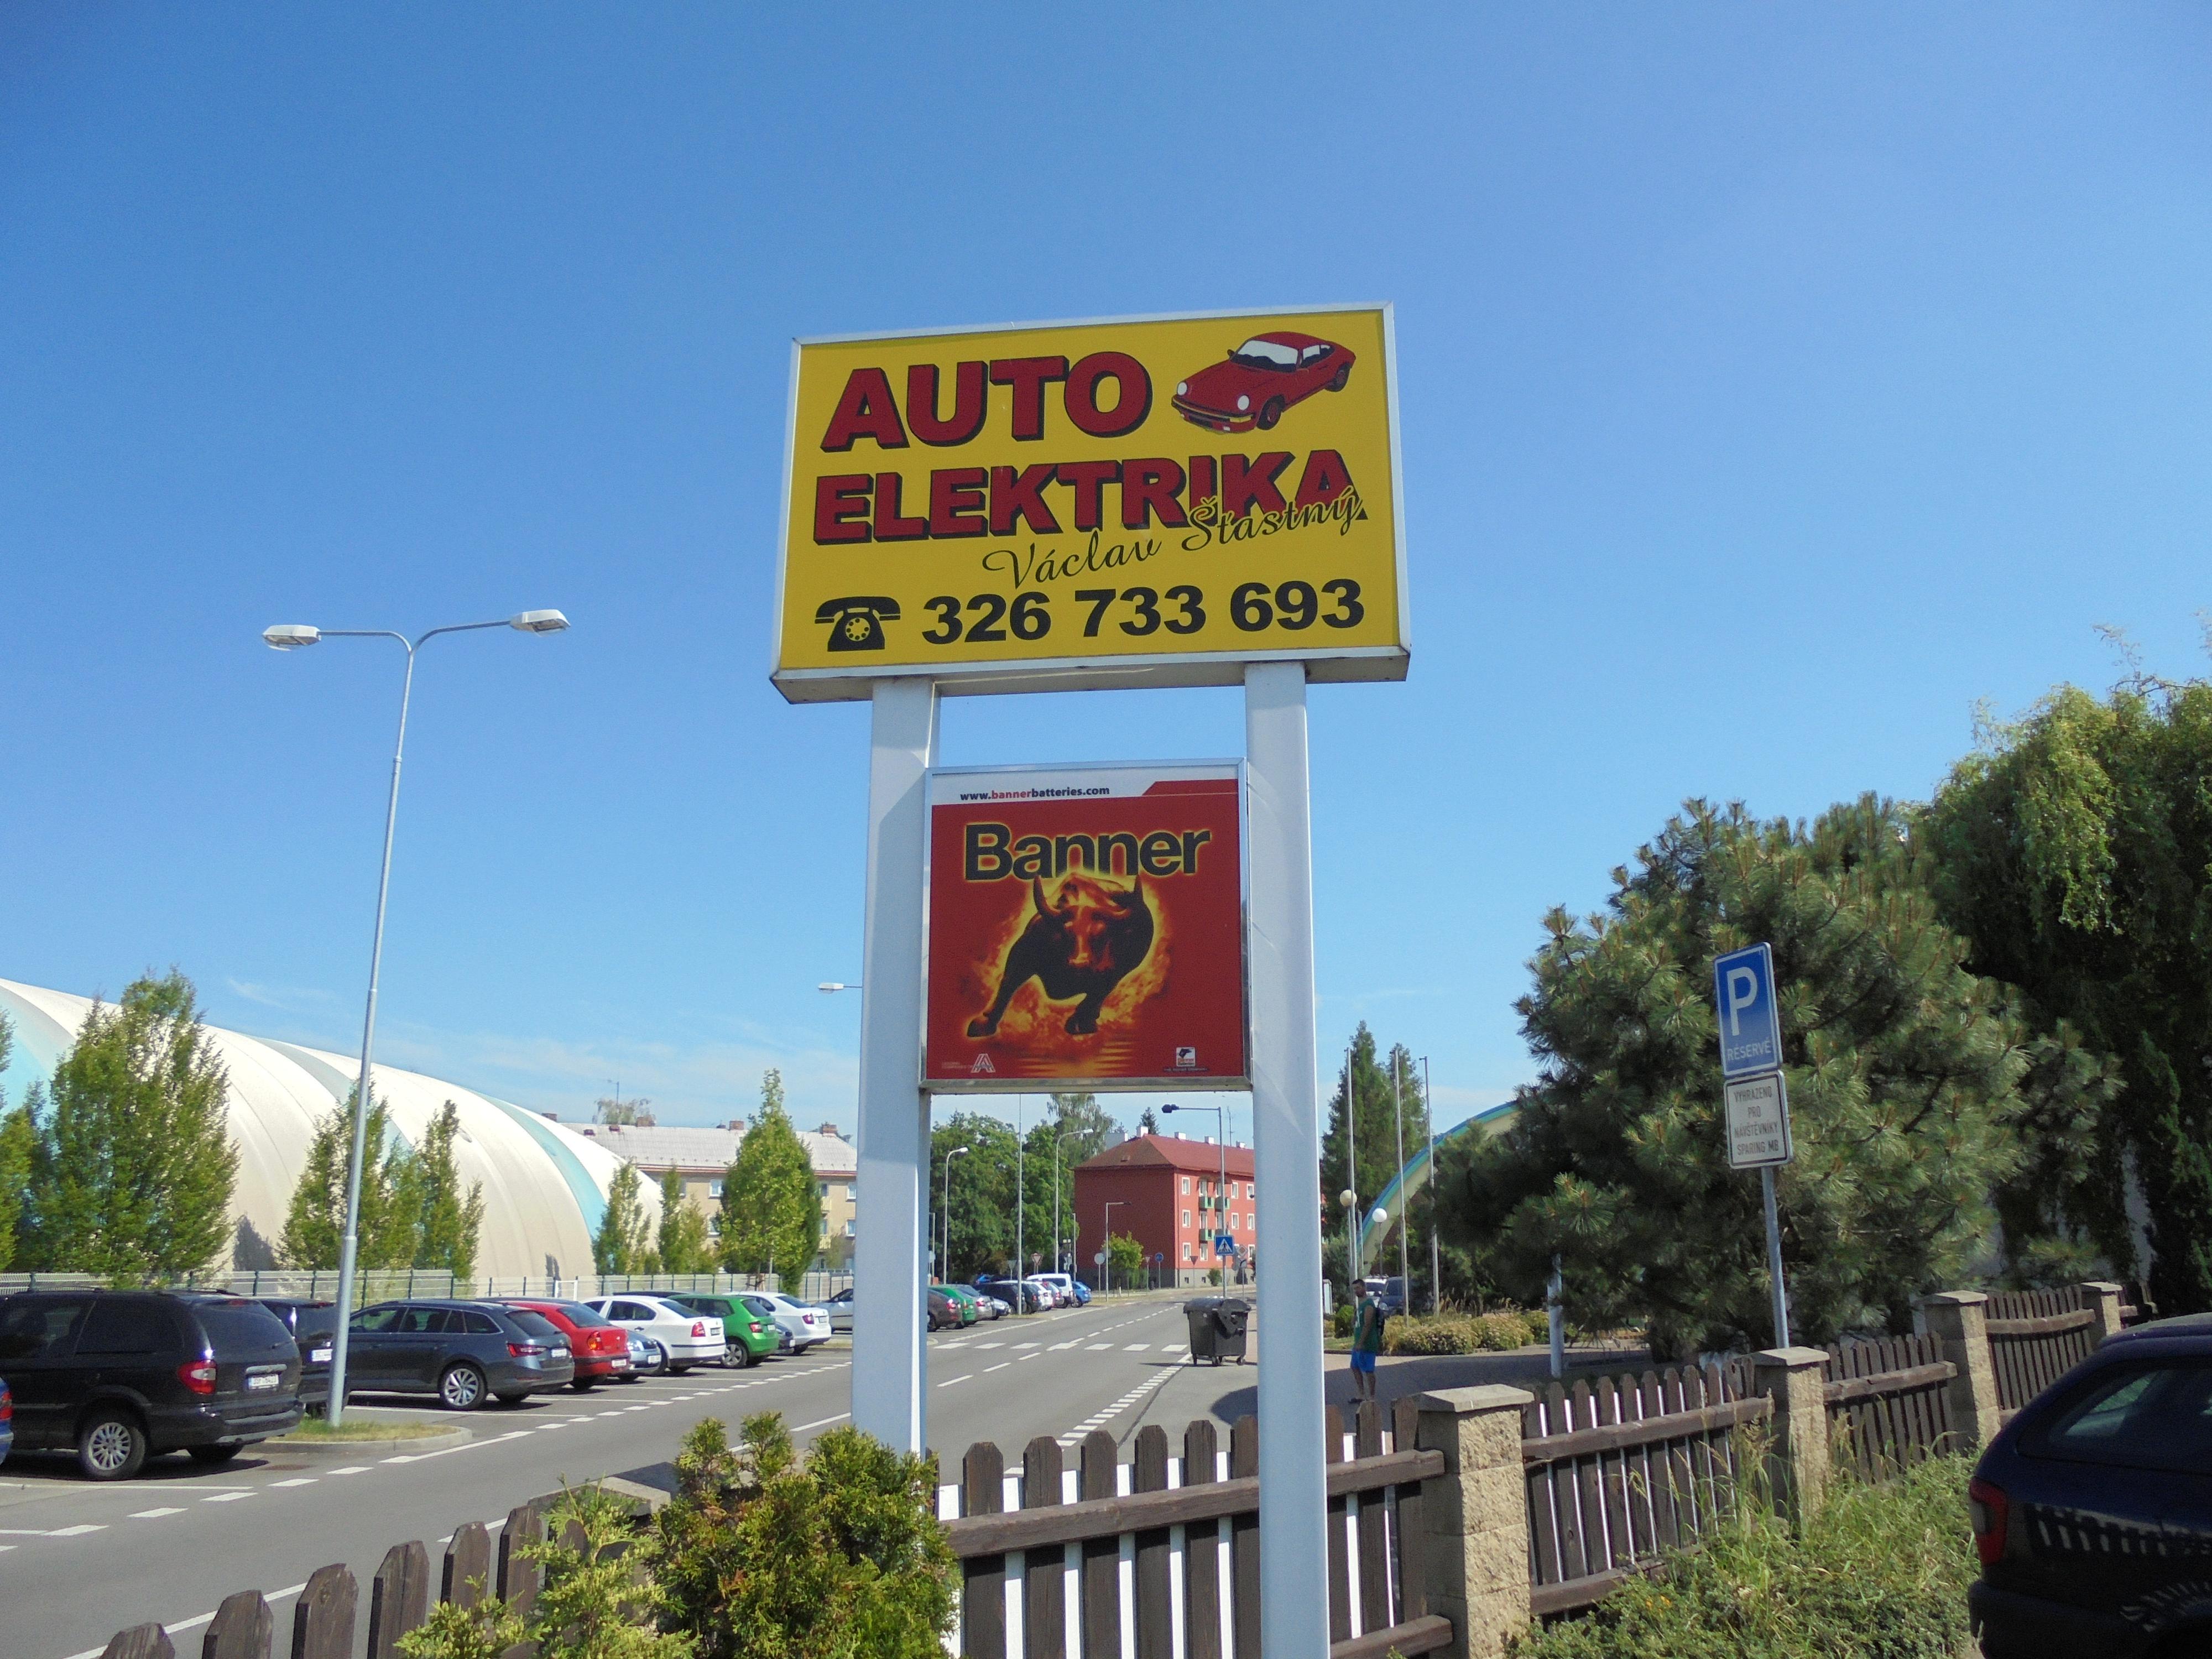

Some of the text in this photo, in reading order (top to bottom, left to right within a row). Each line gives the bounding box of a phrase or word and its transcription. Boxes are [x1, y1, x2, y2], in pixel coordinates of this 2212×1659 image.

[820, 351, 1152, 452] AUTO
[813, 449, 1368, 545] ELEKTRIKA
[982, 485, 1364, 589] Václav Šťastný
[921, 578, 1364, 645] 326 733 693
[960, 787, 1110, 801] www.bannerbatteries.com
[965, 823, 1211, 880] Banner
[1726, 966, 1758, 1036] P
[1734, 1086, 1772, 1102] VYHRAZENO
[1747, 1105, 1761, 1118] PRO
[1737, 1139, 1779, 1156] SPARING MB
